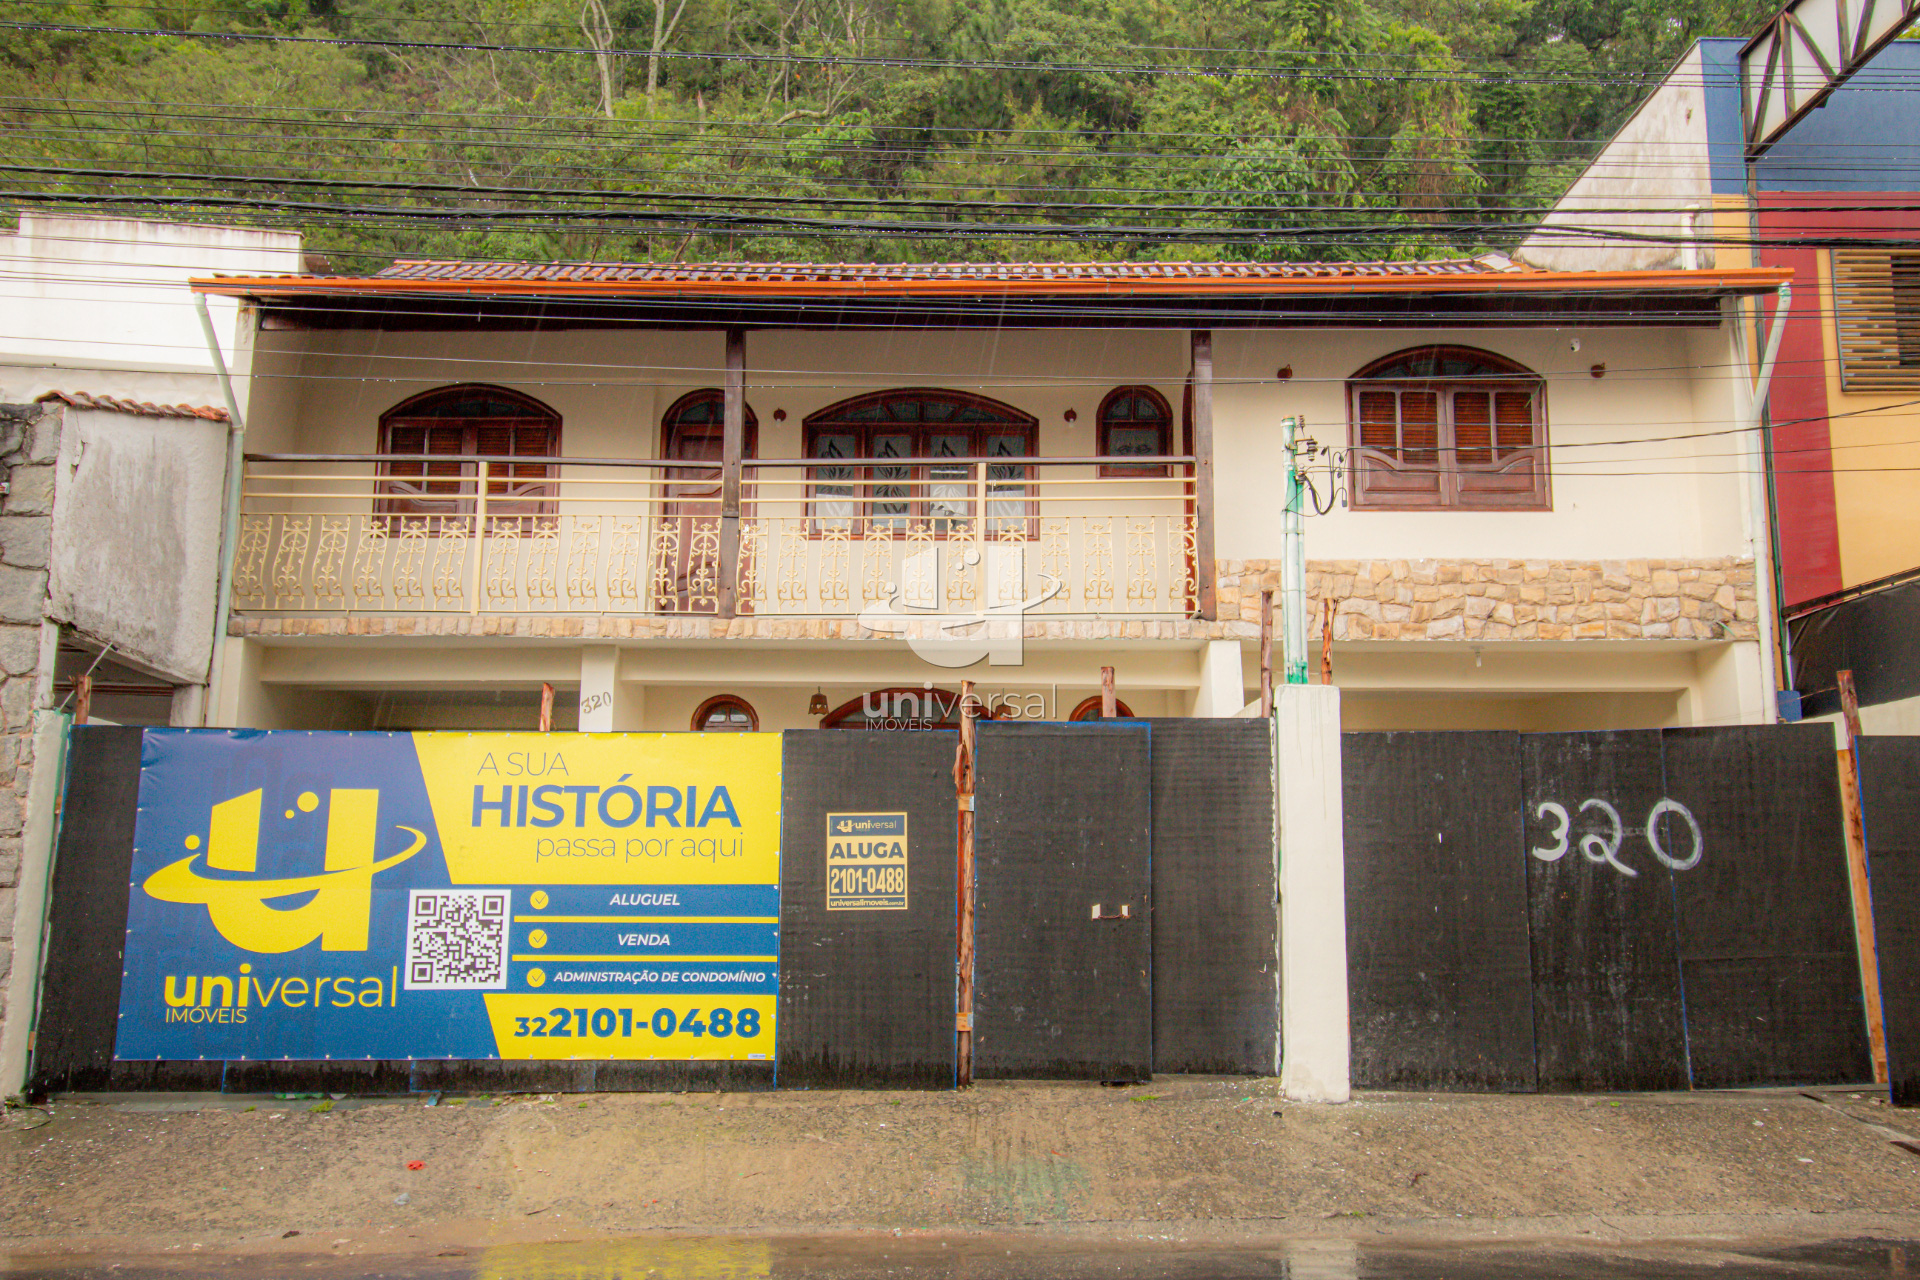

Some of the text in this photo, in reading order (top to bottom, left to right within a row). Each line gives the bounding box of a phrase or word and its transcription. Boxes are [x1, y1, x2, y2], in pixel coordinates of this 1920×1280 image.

[581, 691, 612, 714] 320
[477, 752, 569, 777] A SUA
[471, 773, 742, 829] HISTÓRIA
[855, 820, 897, 829] universal
[536, 831, 744, 863] passa por aqui
[1532, 797, 1704, 878] 320
[829, 842, 905, 859] ALUGA
[830, 867, 904, 894] 2101-0488
[609, 893, 681, 906] ALUGUEL
[617, 933, 671, 946] VENDA
[163, 963, 398, 1008] universal
[553, 970, 766, 984] ADMINISTRAÇÃO DE CONDOMÍNIO
[165, 1004, 248, 1024] IMÓVEIS
